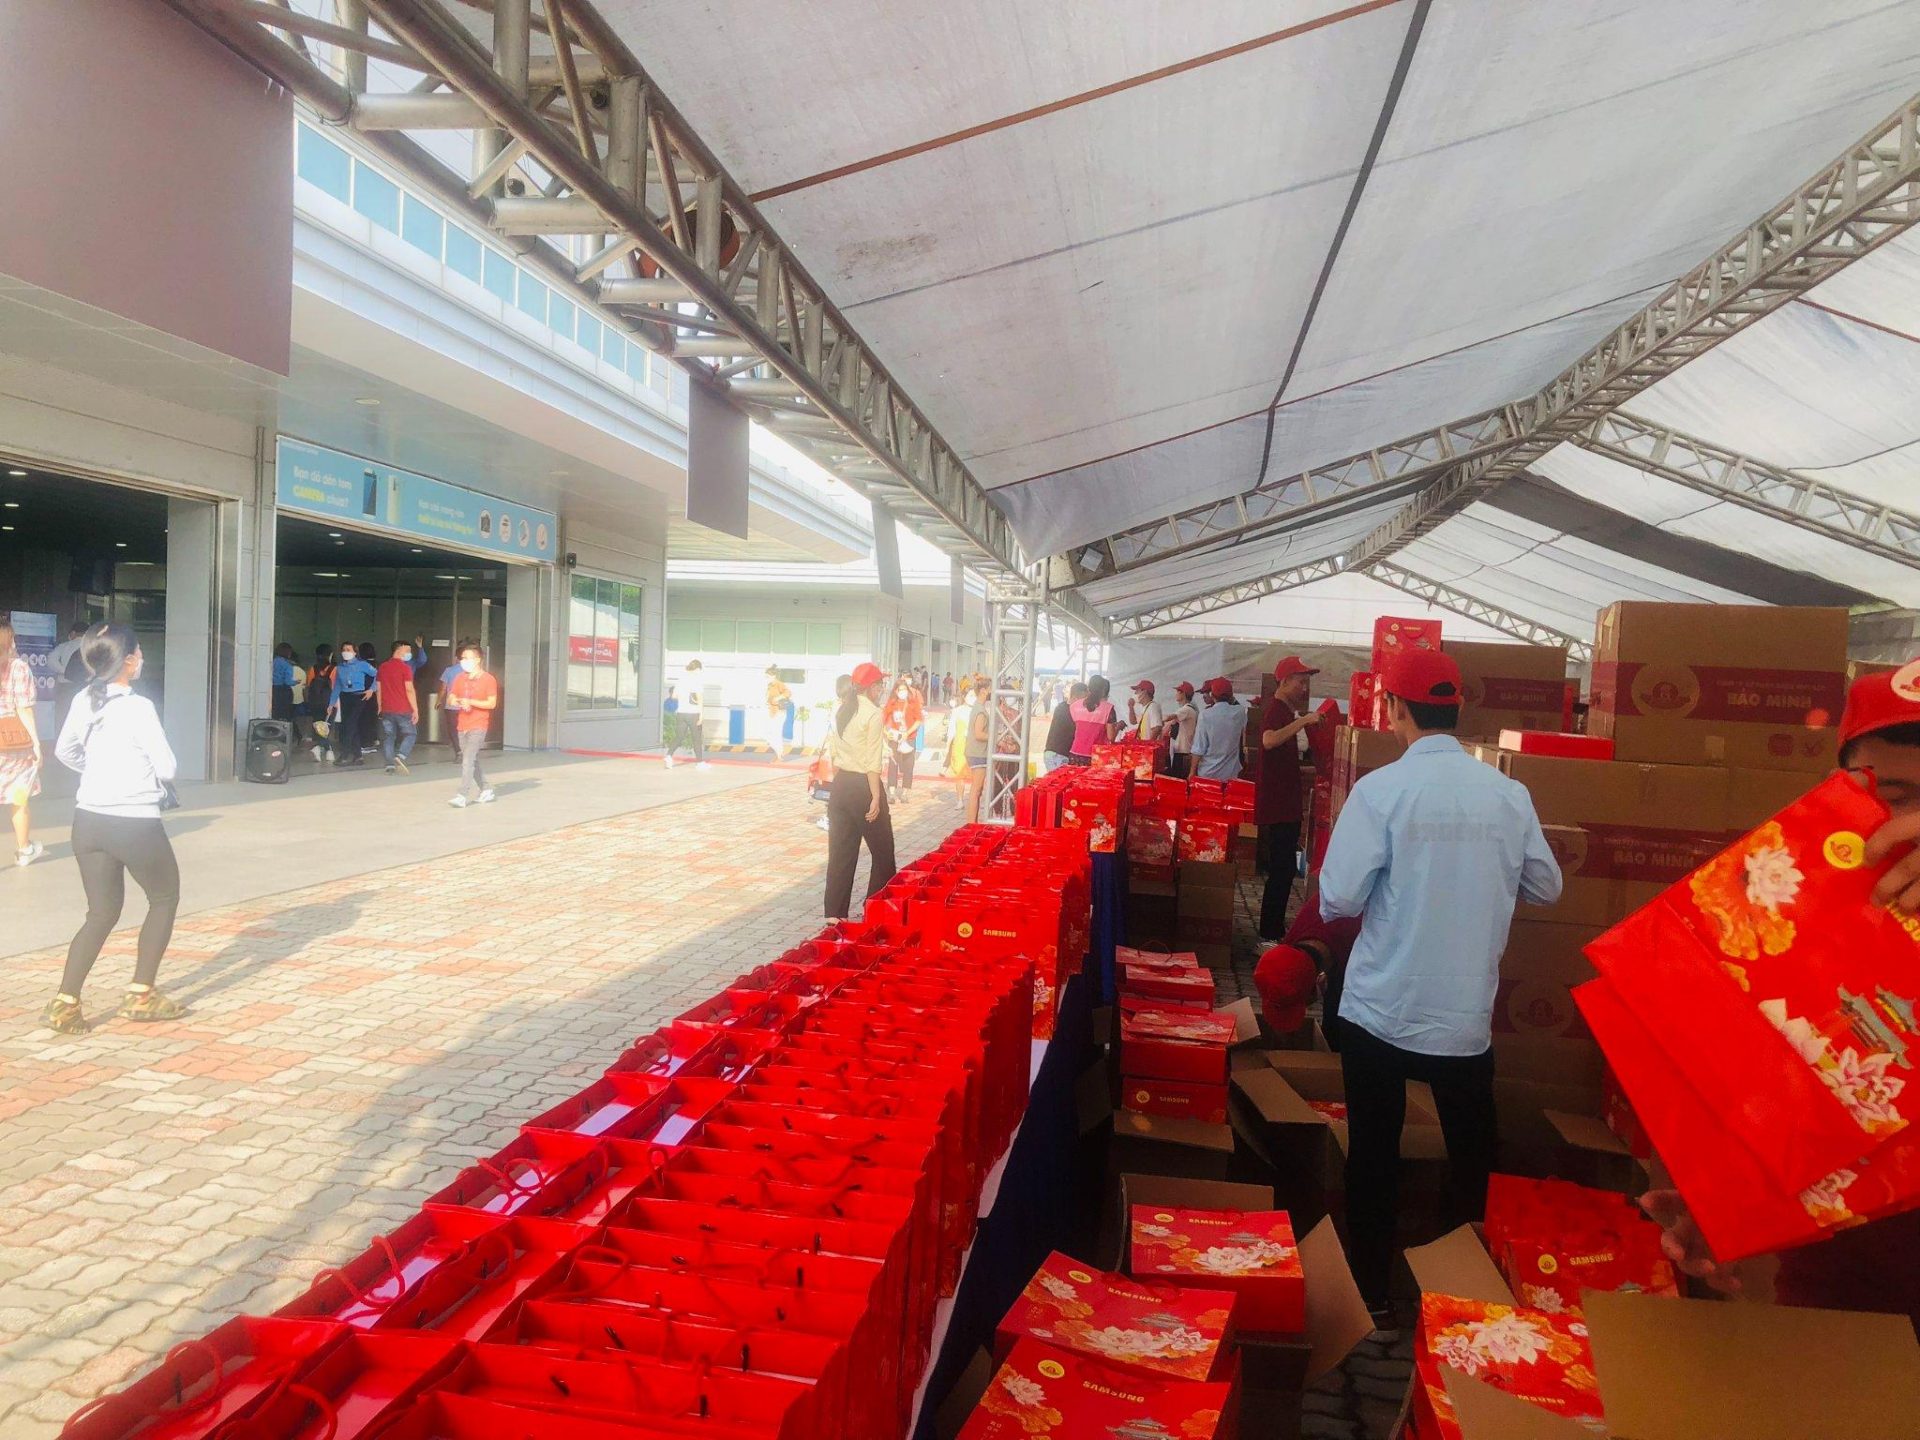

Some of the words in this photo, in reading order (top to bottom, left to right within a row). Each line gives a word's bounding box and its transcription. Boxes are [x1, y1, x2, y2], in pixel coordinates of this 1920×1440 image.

[1766, 695, 1812, 709] MINH
[982, 928, 1017, 938] SAMSUNG
[1188, 1218, 1234, 1226] SAMSUNG
[1570, 1252, 1615, 1266] SAMSUNG
[1108, 1287, 1163, 1303] SAMSUNG
[1082, 1380, 1145, 1403] SAMSUNG
[1512, 1394, 1566, 1406] MSUNG
